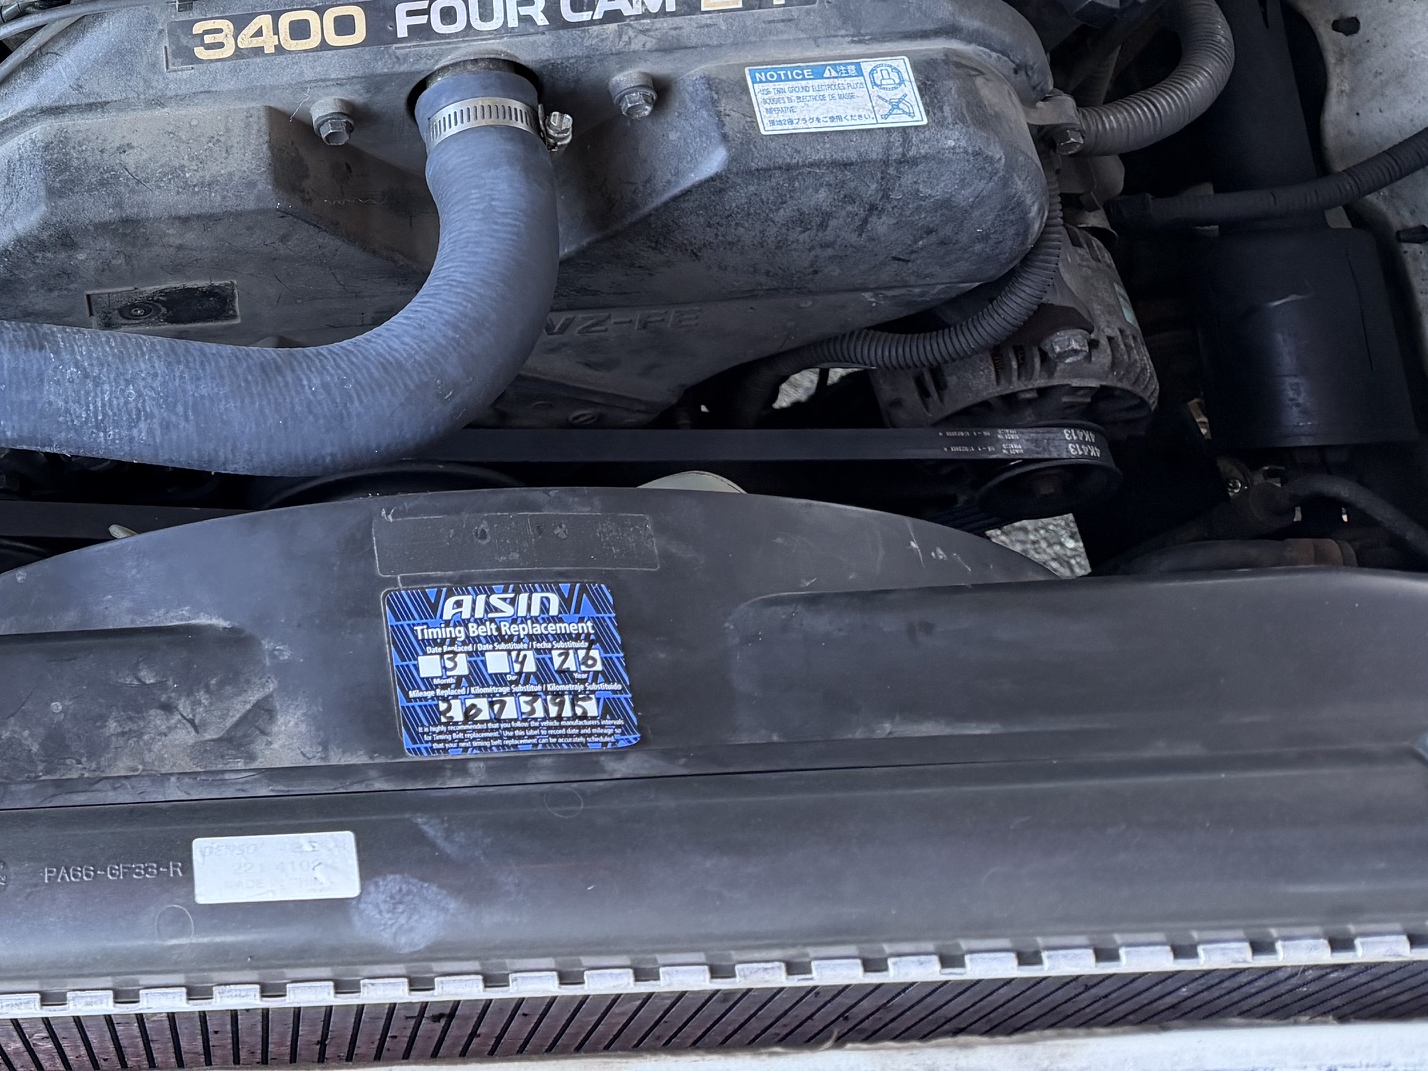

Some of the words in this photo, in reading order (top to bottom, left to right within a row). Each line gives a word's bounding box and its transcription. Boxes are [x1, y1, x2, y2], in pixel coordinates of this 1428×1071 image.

[192, 5, 368, 60] 3400
[755, 69, 814, 82] NOTICE
[837, 65, 859, 77] 注意
[812, 82, 845, 92] ELECTRODES
[1063, 428, 1096, 442] 4K413
[1068, 443, 1101, 457] 4K413
[442, 592, 560, 620] AISIN
[414, 623, 466, 641] Timing
[468, 621, 499, 637] Belt
[500, 619, 595, 639] Replacement
[426, 646, 442, 654] Date
[443, 644, 472, 653] Replaced
[477, 643, 493, 651] Date
[533, 641, 552, 649] Fecha
[552, 640, 589, 649] Substituida
[444, 654, 458, 672] 3
[433, 676, 457, 685] Month
[409, 689, 435, 698] Mileage
[436, 687, 466, 697] Replaced
[547, 683, 584, 692] Kilometraje
[585, 682, 622, 690] Substituido
[424, 733, 432, 741] for
[433, 733, 452, 741] Timing
[548, 727, 566, 735] record
[592, 727, 614, 735] mileage
[430, 725, 446, 733] highly
[448, 723, 486, 731] recommended
[503, 738, 537, 747] replacement
[558, 735, 586, 743] accurately
